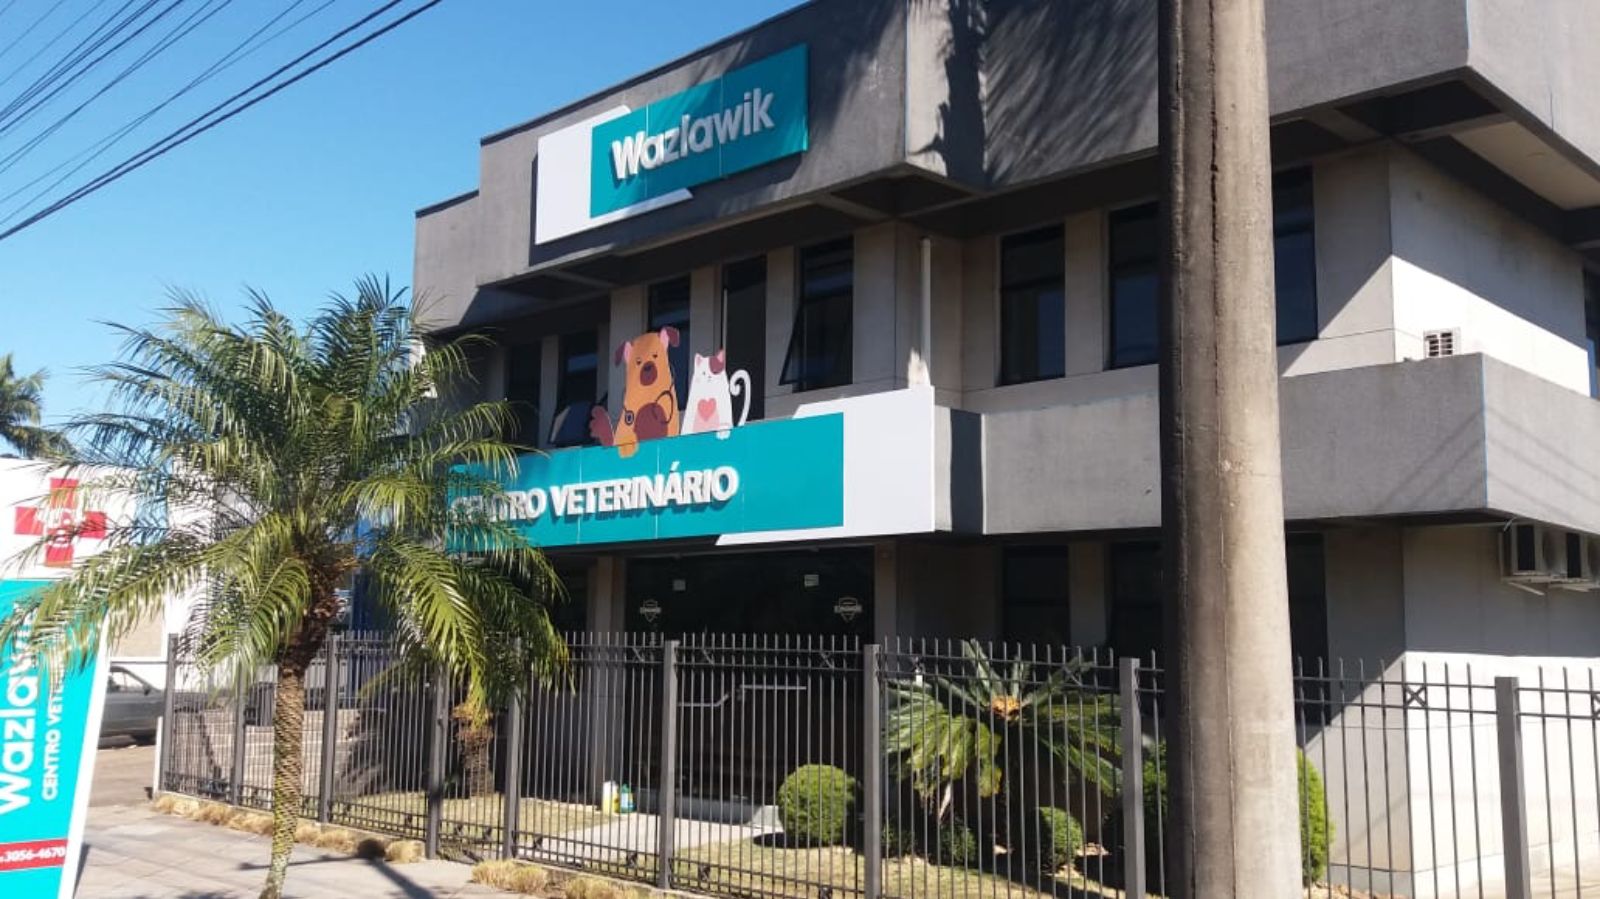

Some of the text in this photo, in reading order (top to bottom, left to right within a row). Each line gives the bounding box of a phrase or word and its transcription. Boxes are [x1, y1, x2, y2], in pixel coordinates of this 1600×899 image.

[611, 88, 775, 180] Wazlawik
[550, 461, 739, 517] VETERINÁRIO
[41, 728, 62, 800] CENTRO
